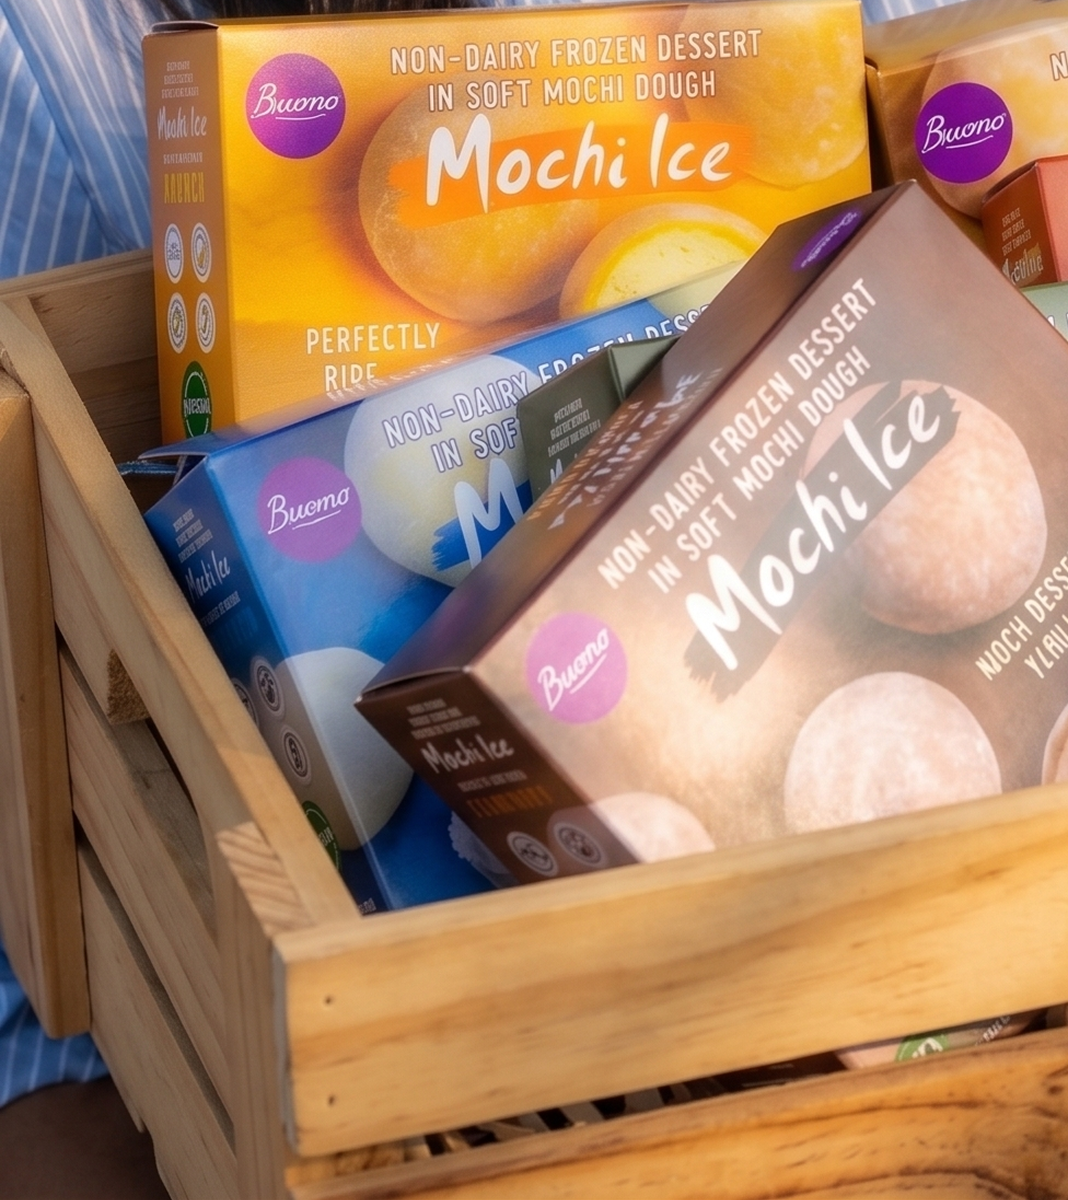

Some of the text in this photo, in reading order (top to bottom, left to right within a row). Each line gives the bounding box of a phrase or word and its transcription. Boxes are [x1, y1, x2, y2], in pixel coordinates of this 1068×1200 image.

[389, 28, 762, 75] NON-DAIRY FROZEN DESSERT
[428, 70, 716, 112] IN SOFT MOCHI DOUGH
[425, 111, 733, 214] Mochi Ice
[306, 322, 441, 355] PERFECTLY
[383, 372, 530, 448] NON-DAIRY
[645, 302, 709, 340] DESS
[431, 440, 463, 473] IN
[468, 417, 518, 460] SOF
[597, 456, 715, 591] NON-DAIRY
[709, 371, 795, 467] FROZEN
[788, 277, 877, 381] DESSERT
[647, 555, 683, 594] IN
[675, 492, 738, 563] SOFT
[732, 419, 806, 501] MOCHI
[797, 345, 872, 428] DOUGH
[684, 394, 941, 672] Mochi Ice
